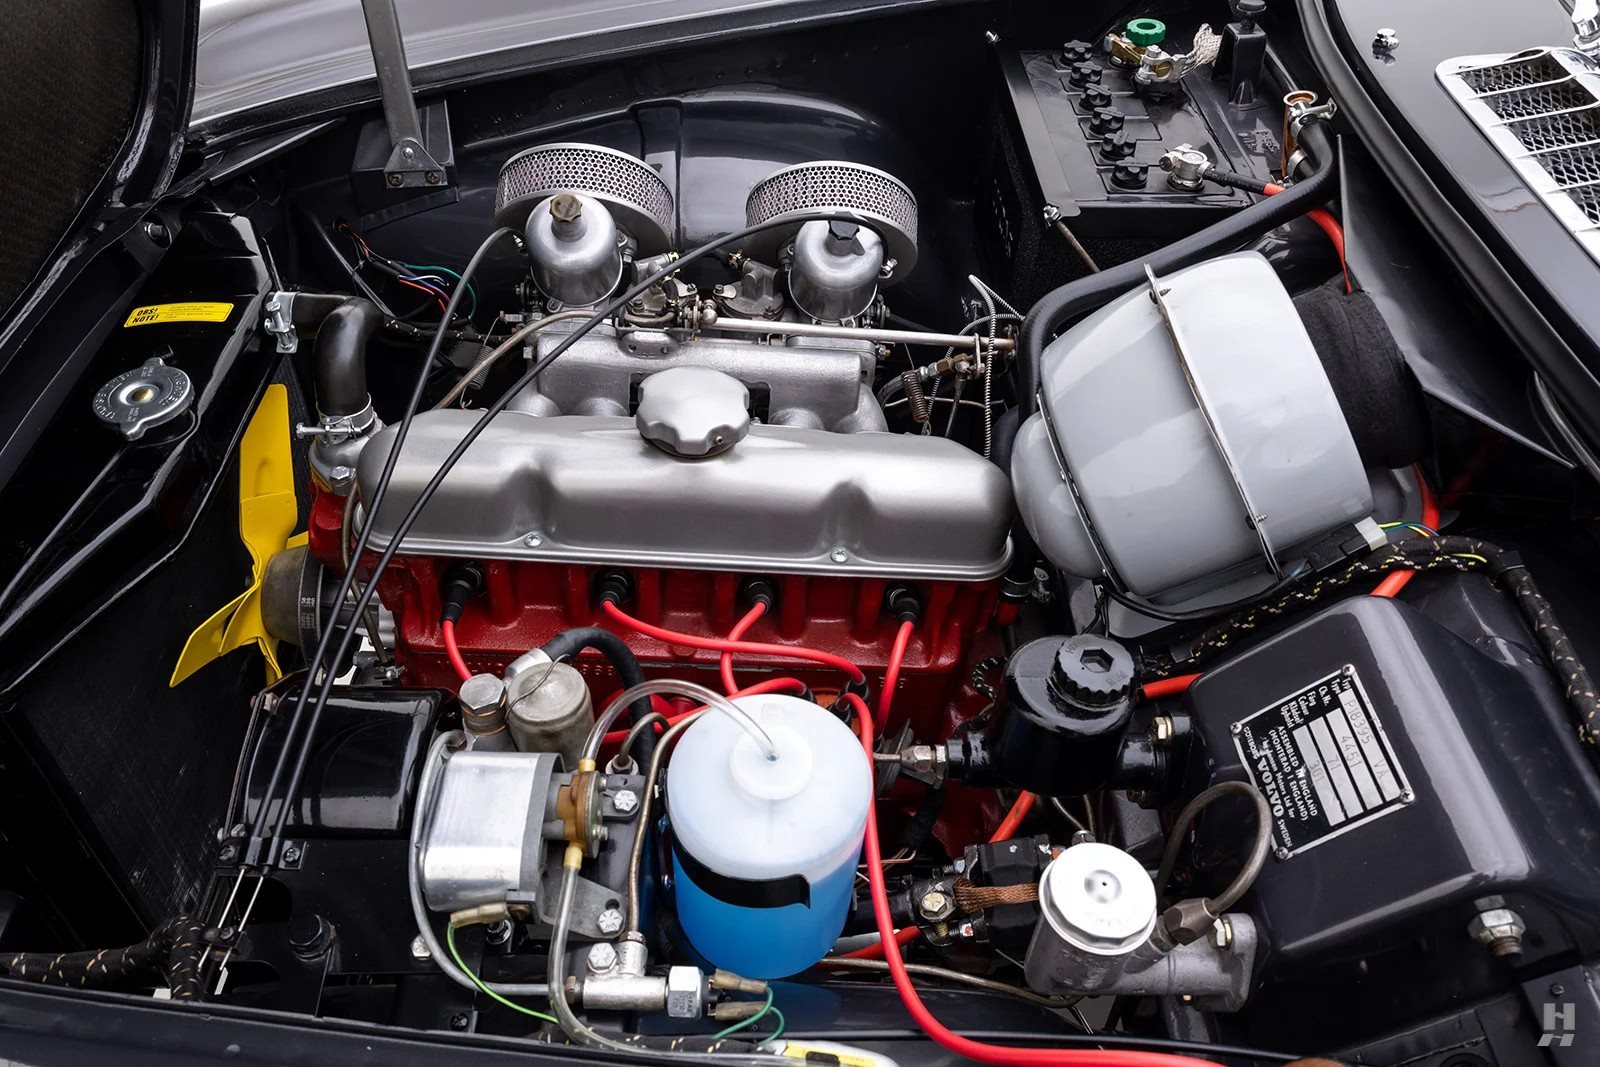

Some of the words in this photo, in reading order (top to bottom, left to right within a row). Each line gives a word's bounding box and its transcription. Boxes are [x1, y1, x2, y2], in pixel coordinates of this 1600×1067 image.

[132, 314, 159, 324] NOTE!
[136, 308, 158, 317] OBS!
[1330, 678, 1343, 695] Type
[1340, 676, 1353, 690] Typ
[1297, 694, 1311, 716] Colour
[1269, 728, 1291, 773] (MONTERAD
[1289, 780, 1308, 821] ENGLAND)
[1278, 724, 1298, 767] ASSEMBLED
[1299, 778, 1317, 817] ENGLAND
[1256, 756, 1284, 818] VOLVO
[1277, 818, 1292, 848] SWEDEN
